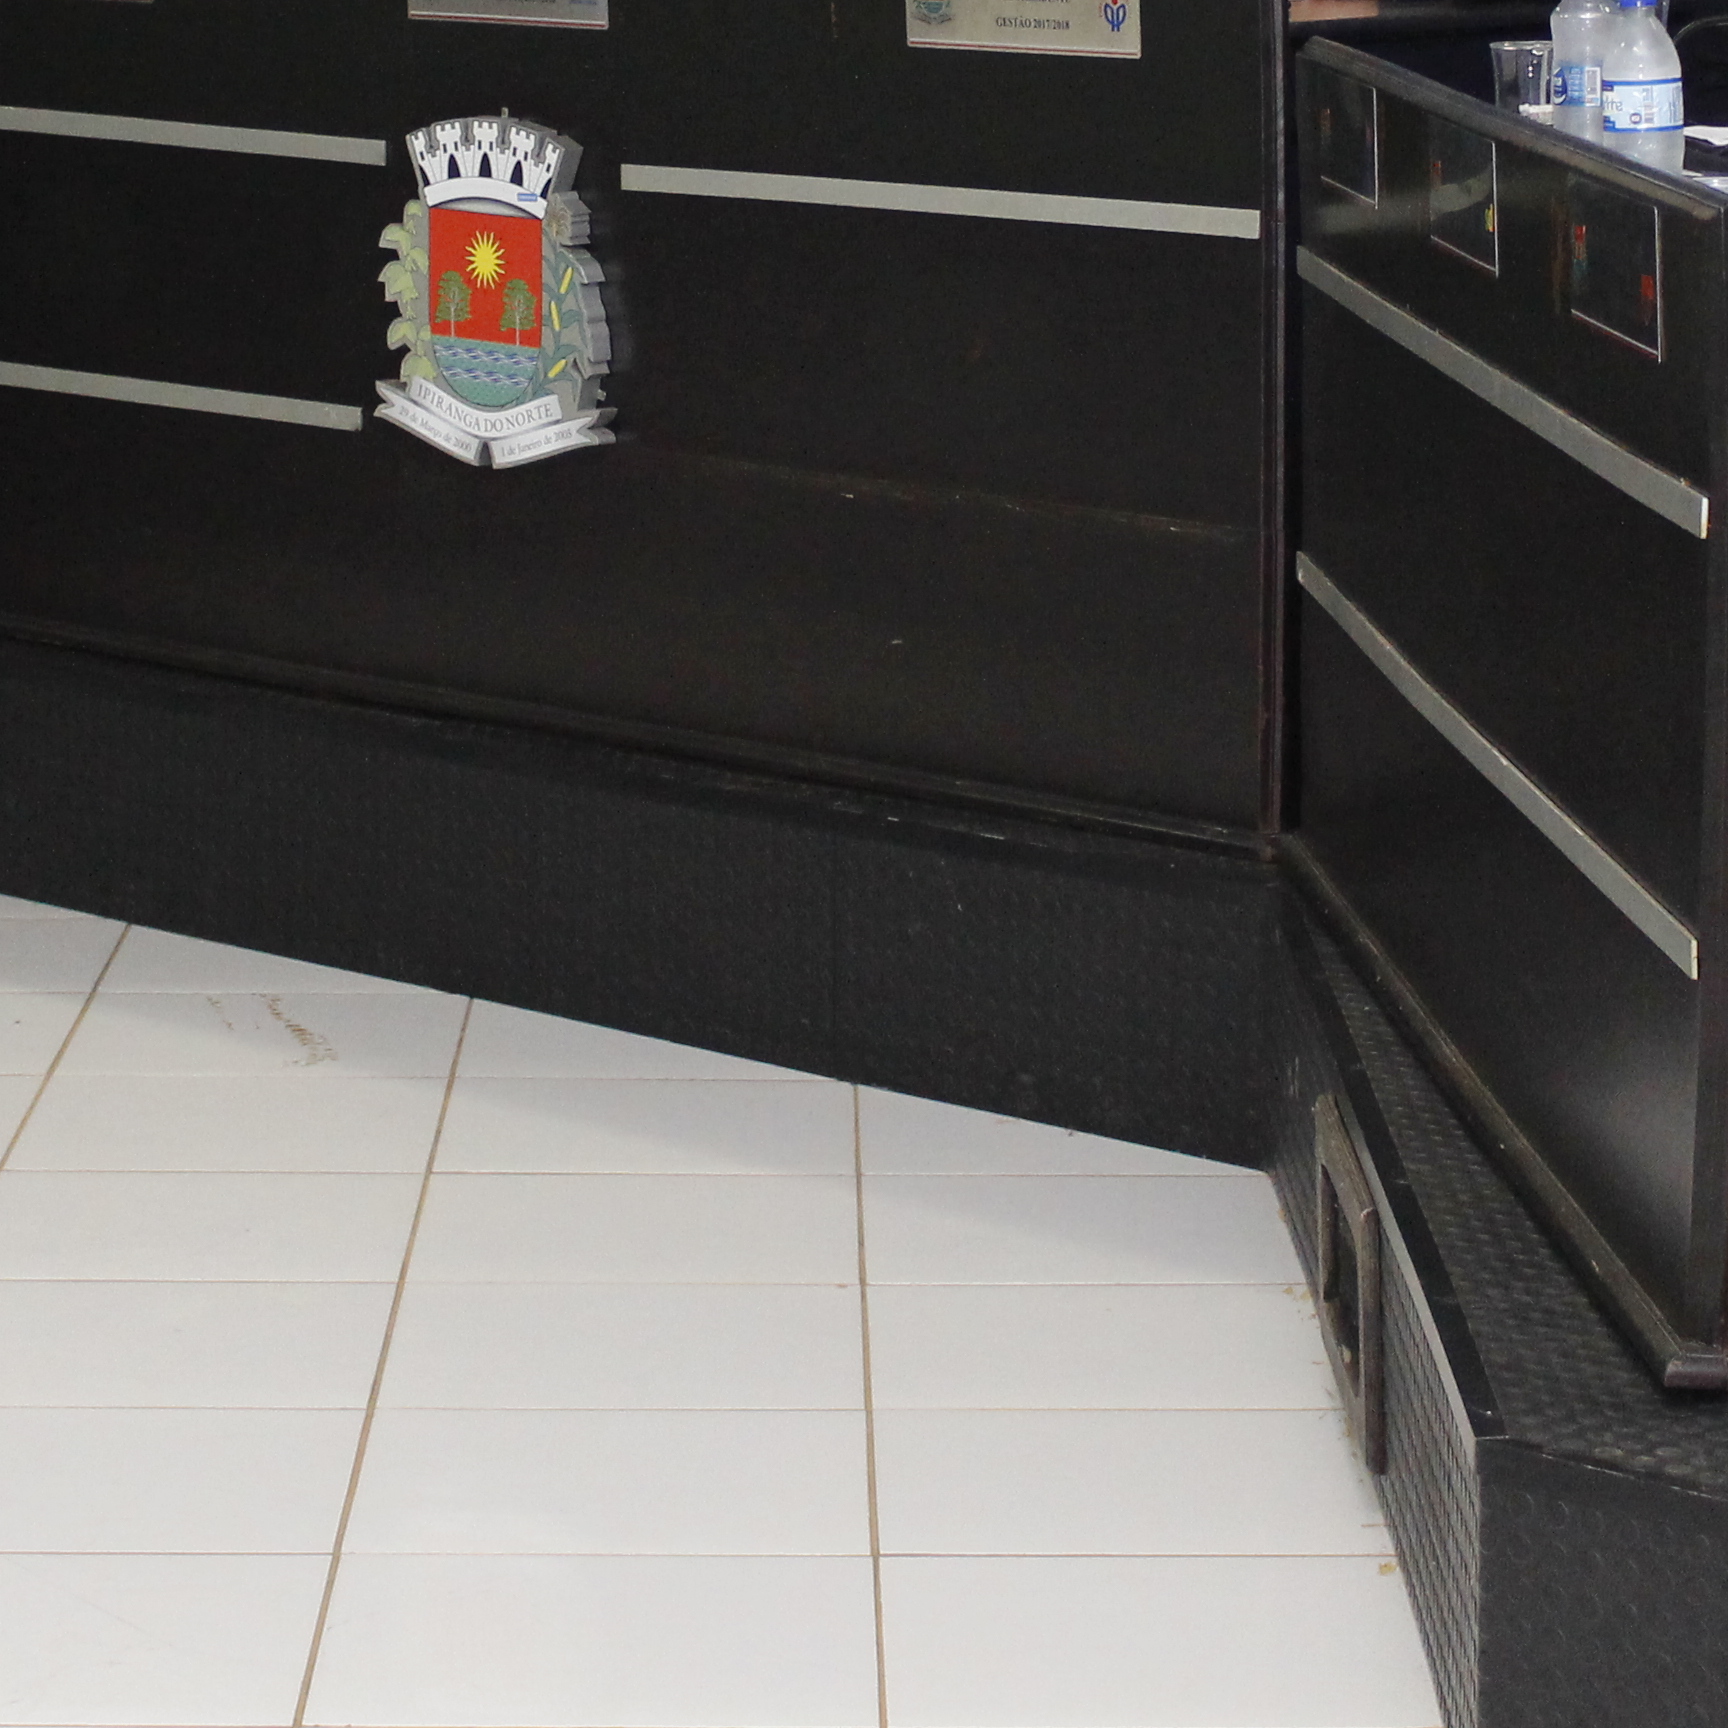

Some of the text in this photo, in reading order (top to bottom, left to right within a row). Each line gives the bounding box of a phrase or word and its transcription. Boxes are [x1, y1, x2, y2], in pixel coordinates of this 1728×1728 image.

[995, 15, 1032, 29] GESTÃO
[416, 383, 554, 433] IPIRANGA DO NORTE
